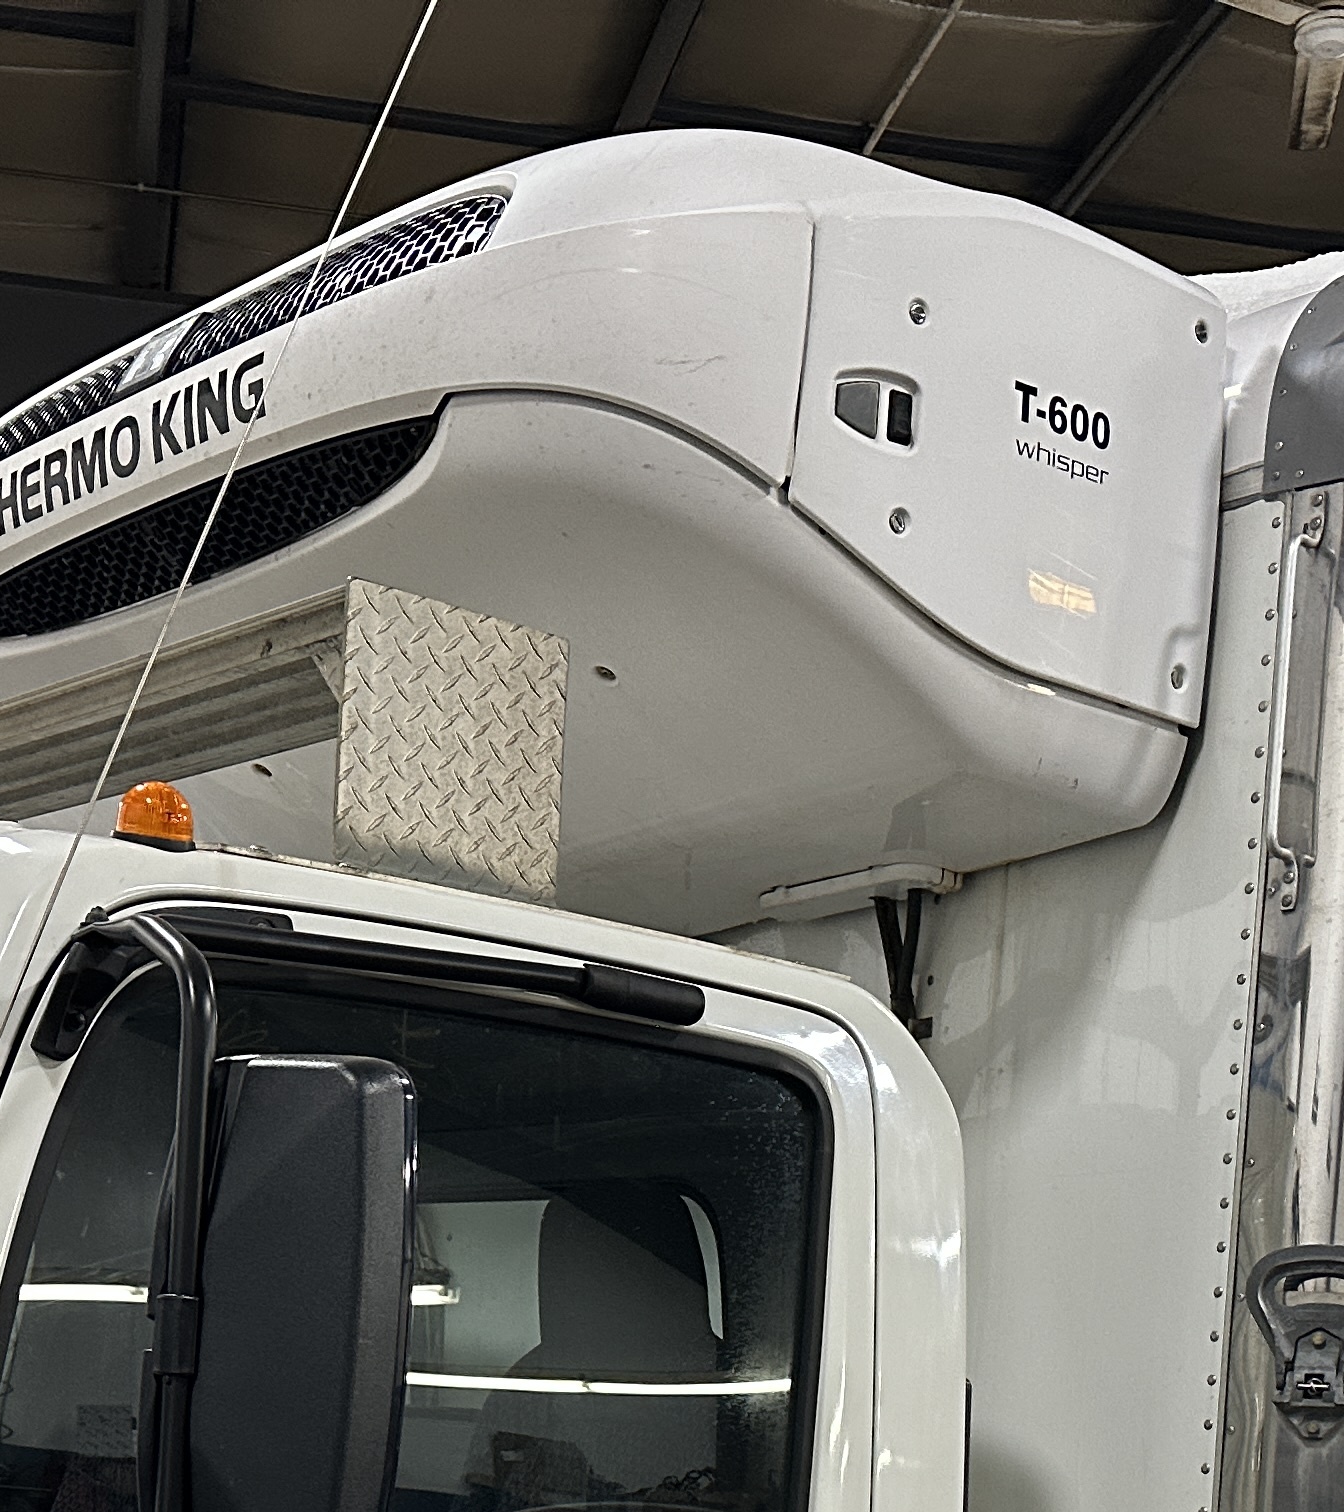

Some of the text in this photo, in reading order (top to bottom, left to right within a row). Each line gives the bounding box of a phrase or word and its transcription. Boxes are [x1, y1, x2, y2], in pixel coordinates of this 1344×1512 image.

[152, 351, 267, 465] KING
[1014, 379, 1111, 450] T-600
[1015, 438, 1110, 485] whisper
